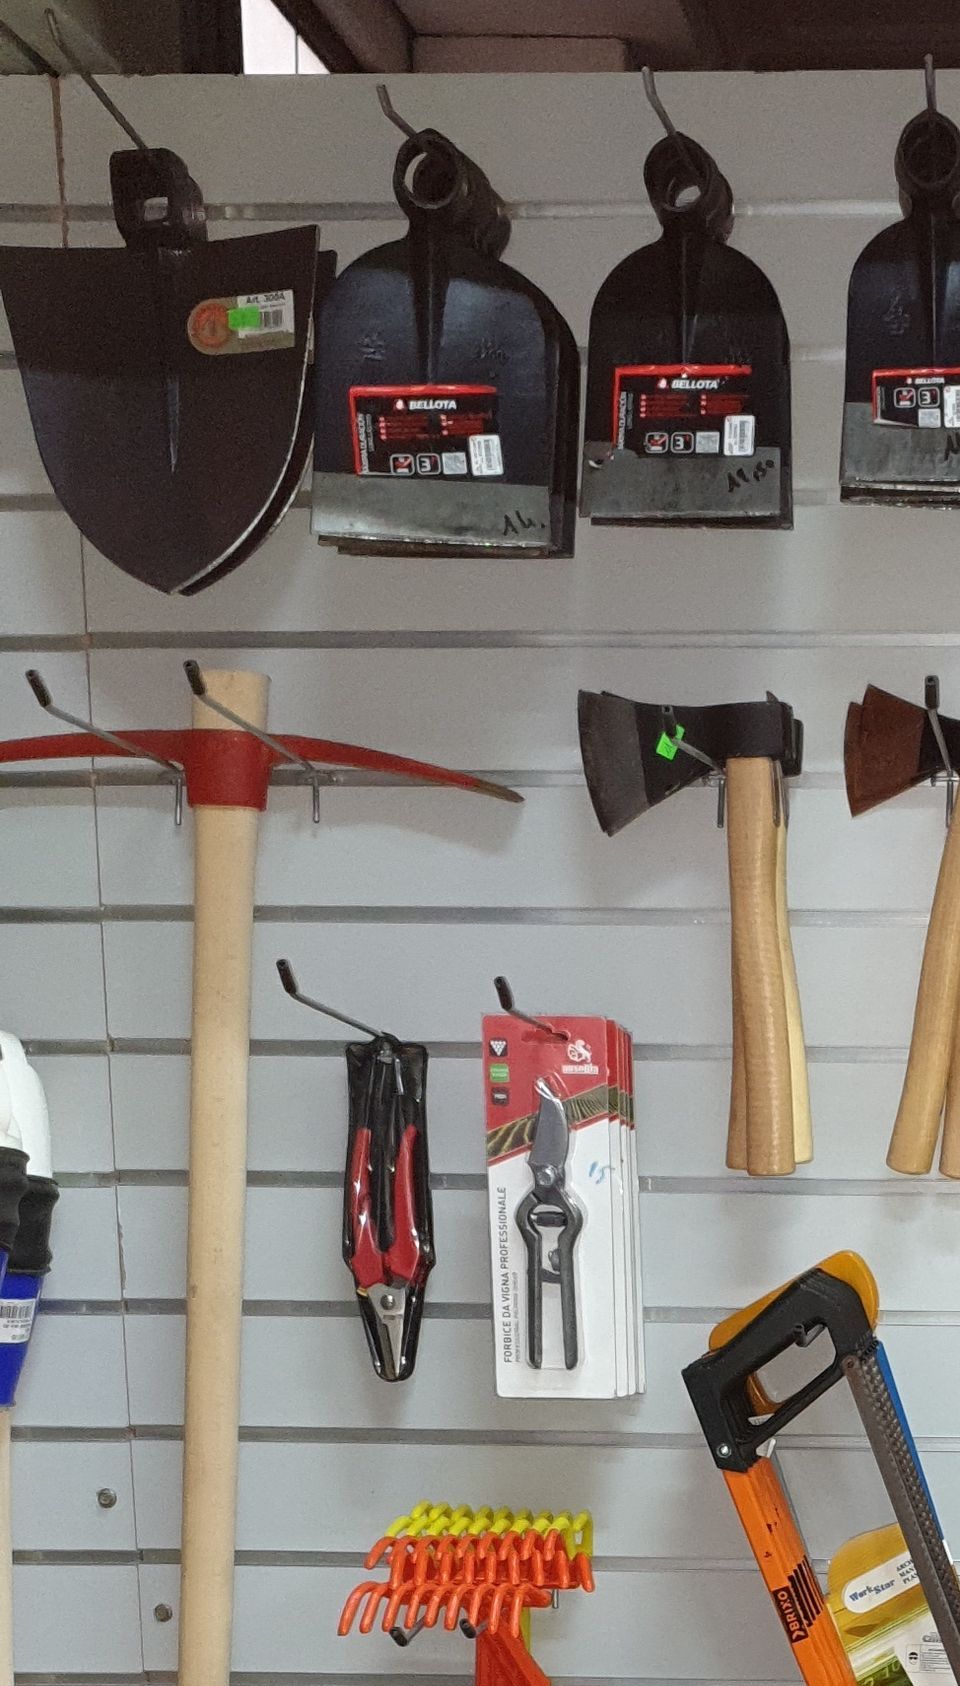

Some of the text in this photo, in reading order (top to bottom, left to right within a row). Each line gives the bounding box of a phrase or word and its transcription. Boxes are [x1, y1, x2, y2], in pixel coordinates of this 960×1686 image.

[671, 378, 720, 389] BELLOTA
[408, 399, 458, 410] BELLOTA
[496, 1187, 513, 1363] FORBICE DA VIGNA PROFESSIONALE
[777, 1591, 801, 1630] BRIXO
